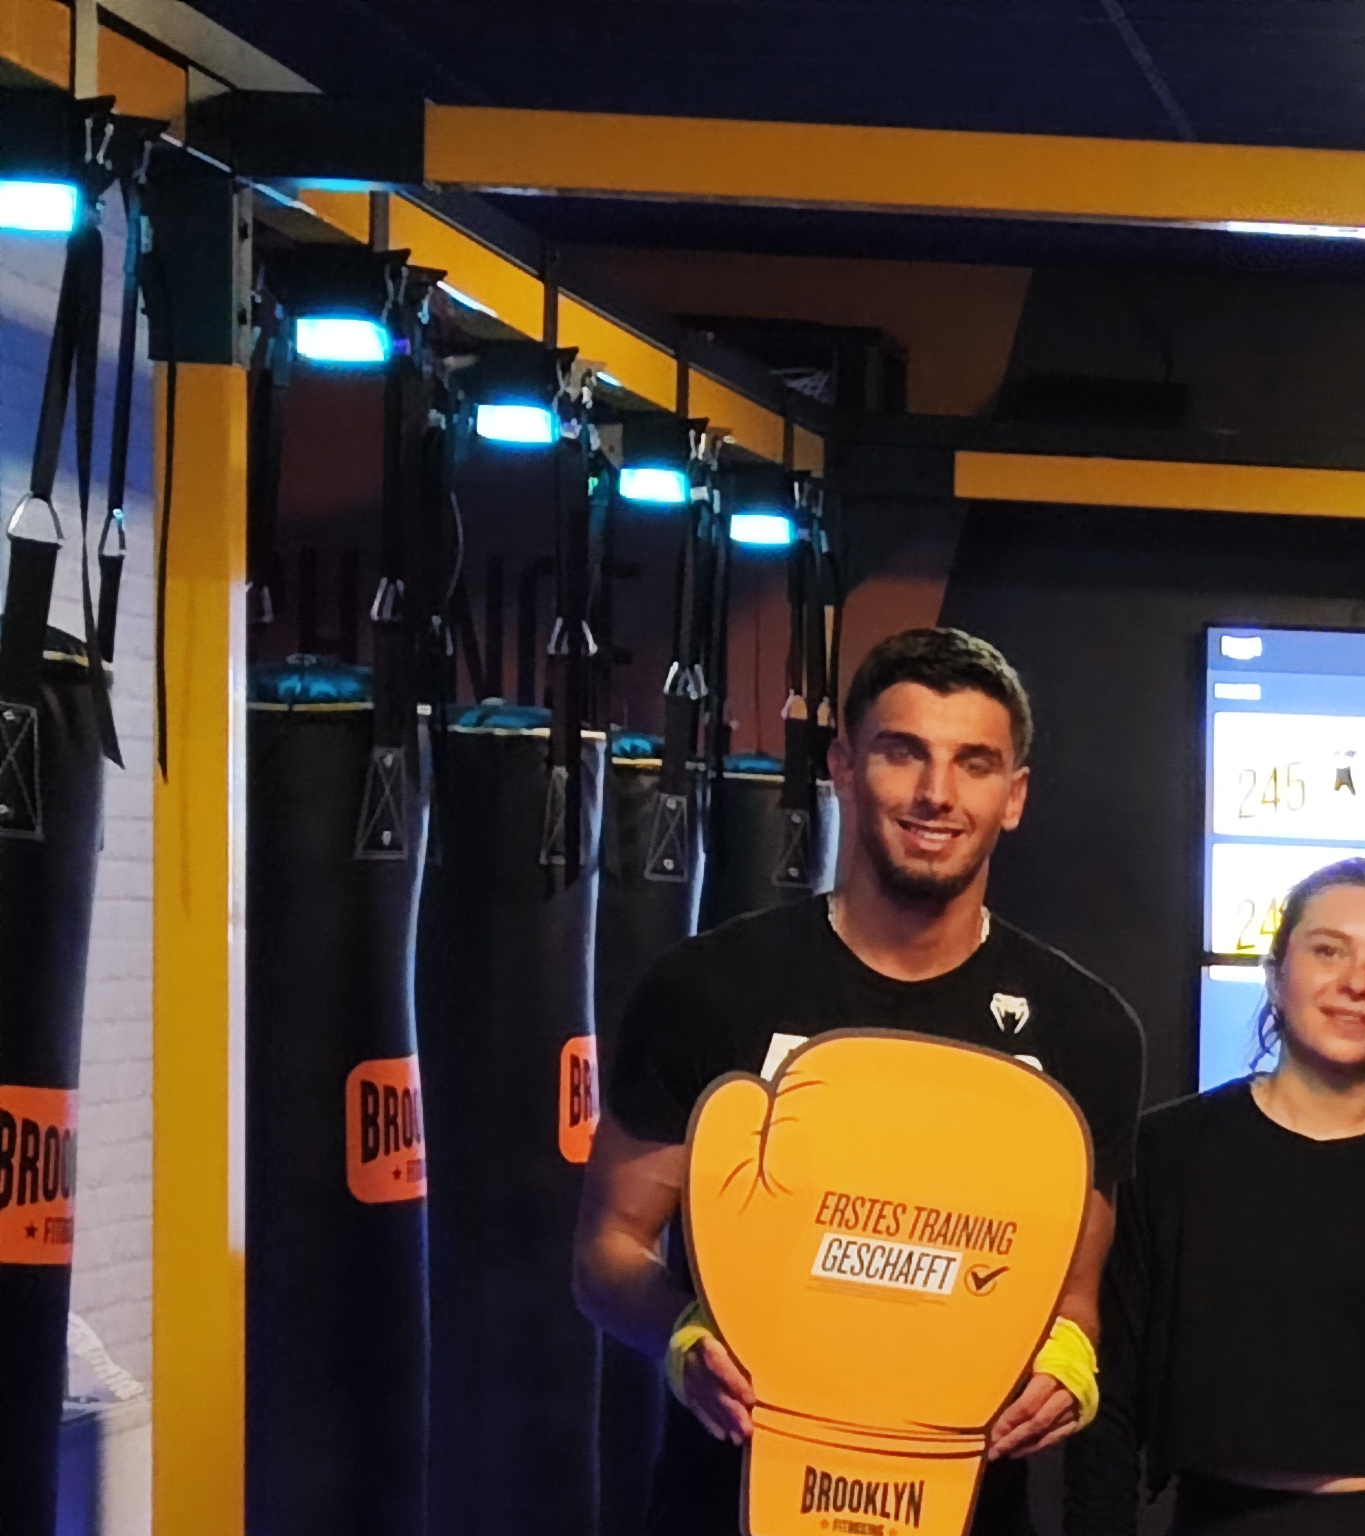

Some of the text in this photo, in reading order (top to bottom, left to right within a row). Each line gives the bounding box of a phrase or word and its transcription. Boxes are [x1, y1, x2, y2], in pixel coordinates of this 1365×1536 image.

[815, 1190, 1018, 1256] ERSTES TRAINING
[821, 1237, 957, 1291] GESCHAFFT
[800, 1465, 925, 1529] BROOKLYN
